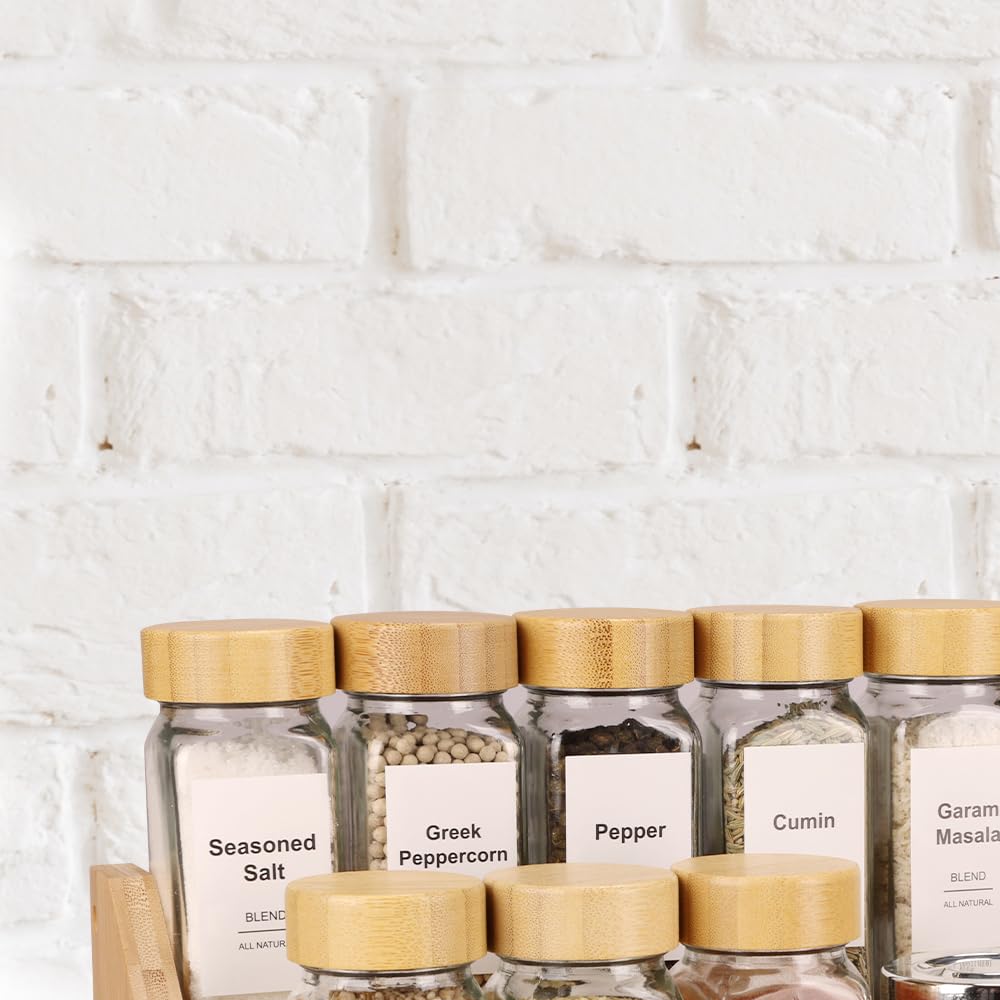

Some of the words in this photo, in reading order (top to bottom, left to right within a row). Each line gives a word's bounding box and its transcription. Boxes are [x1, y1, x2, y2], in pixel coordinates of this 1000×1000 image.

[772, 811, 836, 831] Cumin
[937, 802, 1000, 820] Garam
[425, 823, 482, 841] Greek
[595, 823, 667, 844] Pepper
[936, 825, 1000, 846] Masala
[208, 832, 317, 857] Seasoned
[399, 849, 508, 870] Peppercorn
[243, 862, 286, 882] Salt
[950, 870, 987, 883] BLEND
[943, 900, 958, 909] ALL
[958, 897, 994, 909] NATURAL
[238, 942, 255, 951] ALL
[256, 939, 286, 949] NATUR
